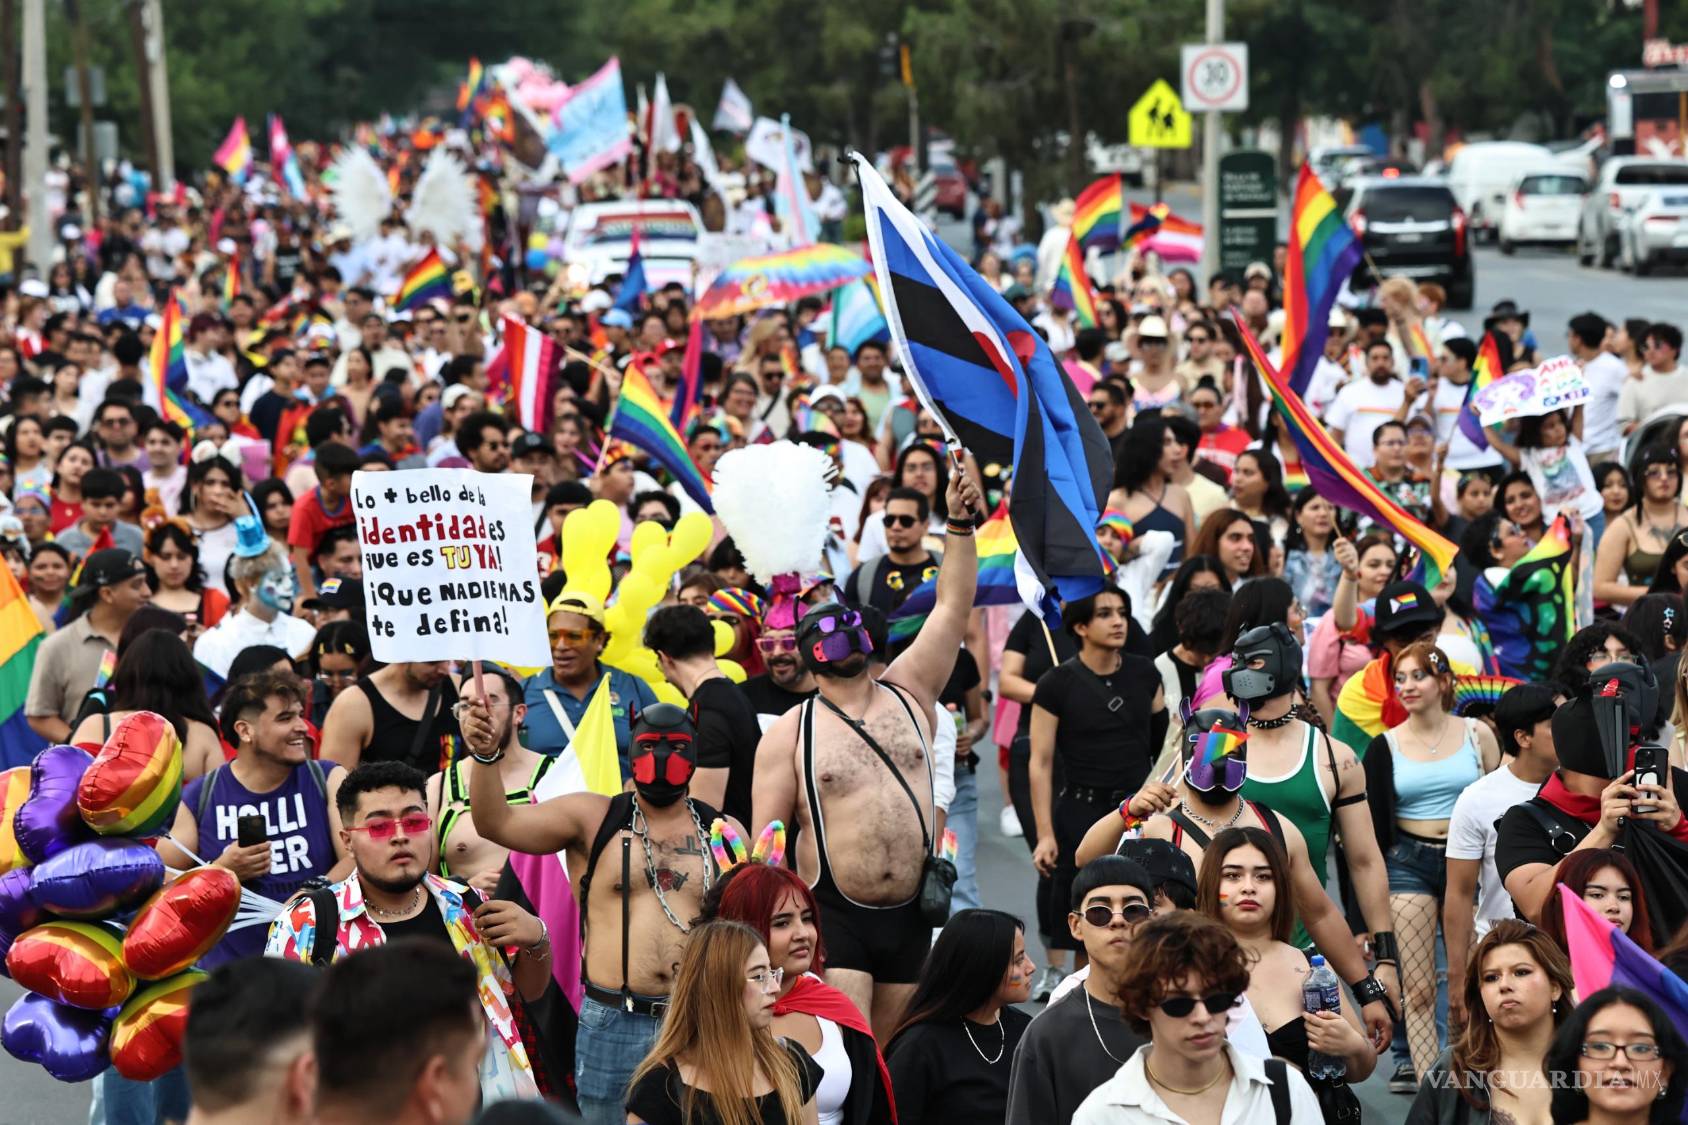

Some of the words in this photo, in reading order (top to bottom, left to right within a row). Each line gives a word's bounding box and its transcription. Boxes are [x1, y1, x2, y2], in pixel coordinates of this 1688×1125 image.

[406, 484, 451, 504] bello
[458, 485, 475, 503] de
[478, 486, 486, 506] la
[361, 513, 506, 545] identidades
[406, 549, 434, 566] es
[372, 615, 395, 637] te
[416, 606, 509, 636] defina!
